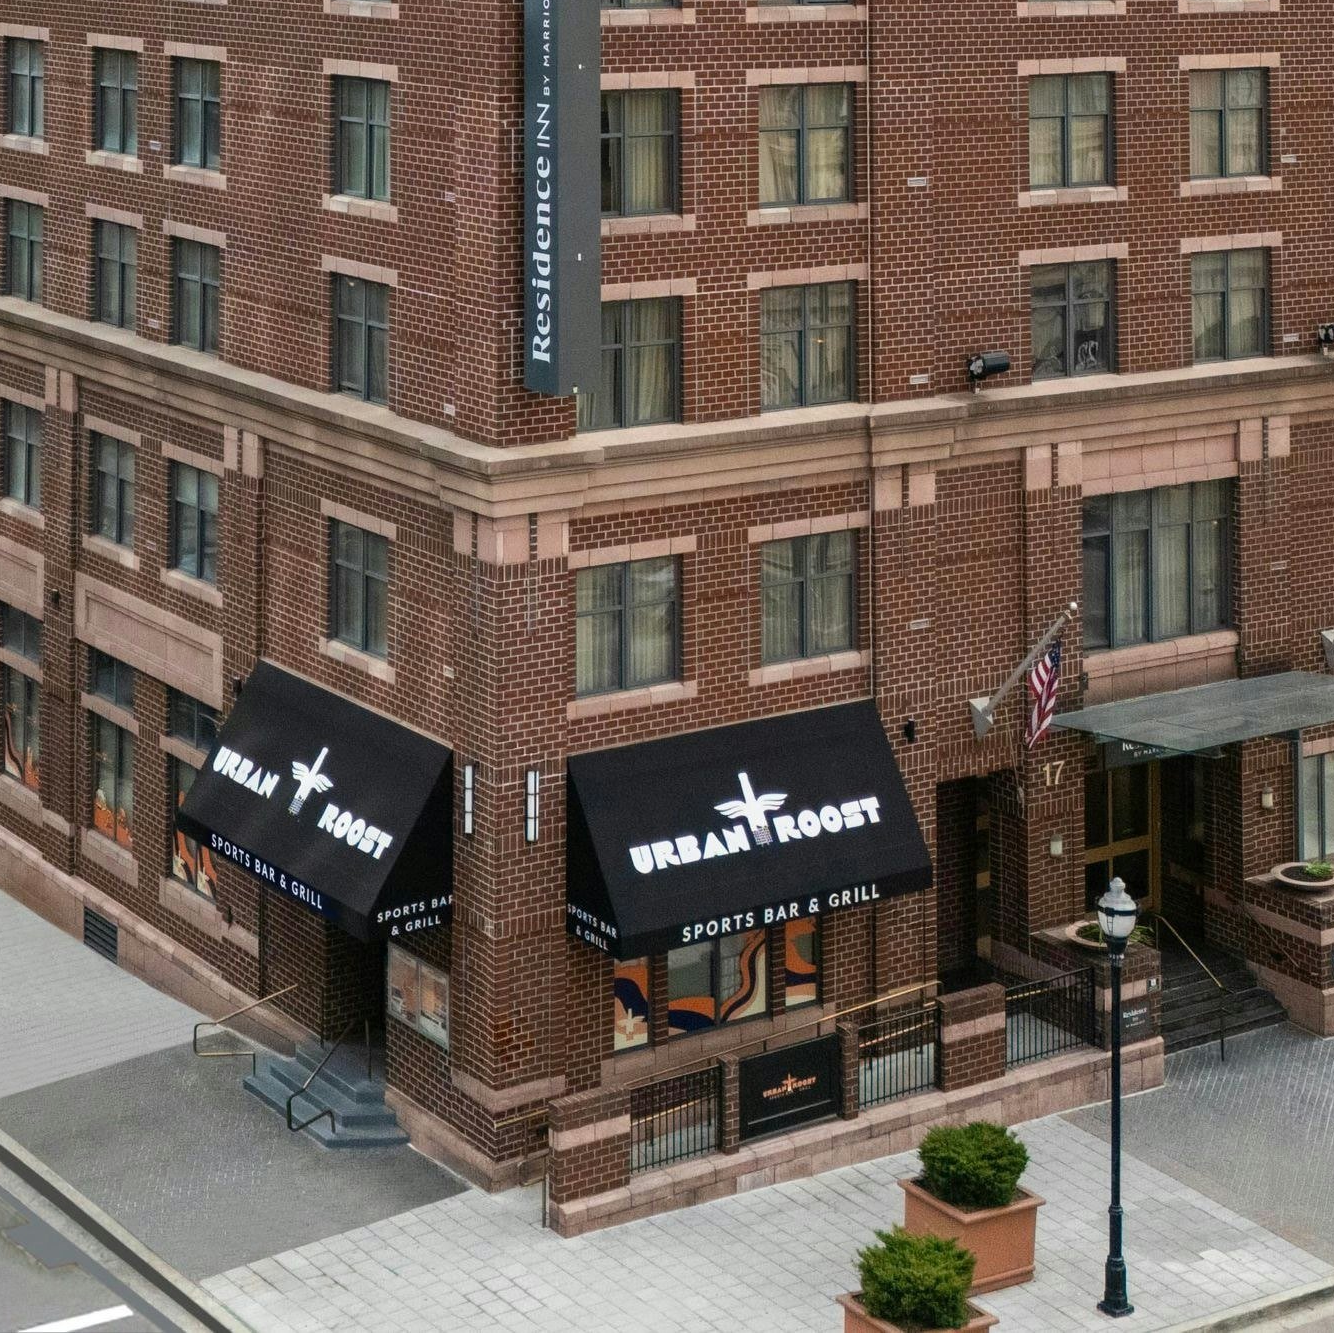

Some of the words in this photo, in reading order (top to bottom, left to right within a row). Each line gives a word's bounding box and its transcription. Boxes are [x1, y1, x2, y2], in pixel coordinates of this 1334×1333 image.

[543, 75, 551, 96] BY
[536, 103, 551, 148] INN
[531, 156, 551, 364] Residence
[1042, 760, 1065, 786] 17
[213, 745, 280, 799] URBAN
[317, 803, 394, 860] ROOST
[628, 824, 751, 874] URBAN
[772, 796, 881, 843] ROOST
[211, 834, 250, 868] SPORTS
[255, 860, 276, 884] BAR
[280, 875, 287, 890] &
[291, 882, 323, 911] GRILL
[377, 902, 426, 923] SPORTS
[390, 925, 399, 936] &
[405, 915, 441, 932] GRILL
[567, 902, 598, 928] SPORTS
[600, 920, 617, 939] BAR
[682, 912, 755, 943] SPORTS
[764, 902, 799, 924] BAR
[808, 897, 819, 913] &
[829, 884, 880, 908] GRILL
[575, 925, 582, 936] &
[584, 929, 609, 951] GRILL
